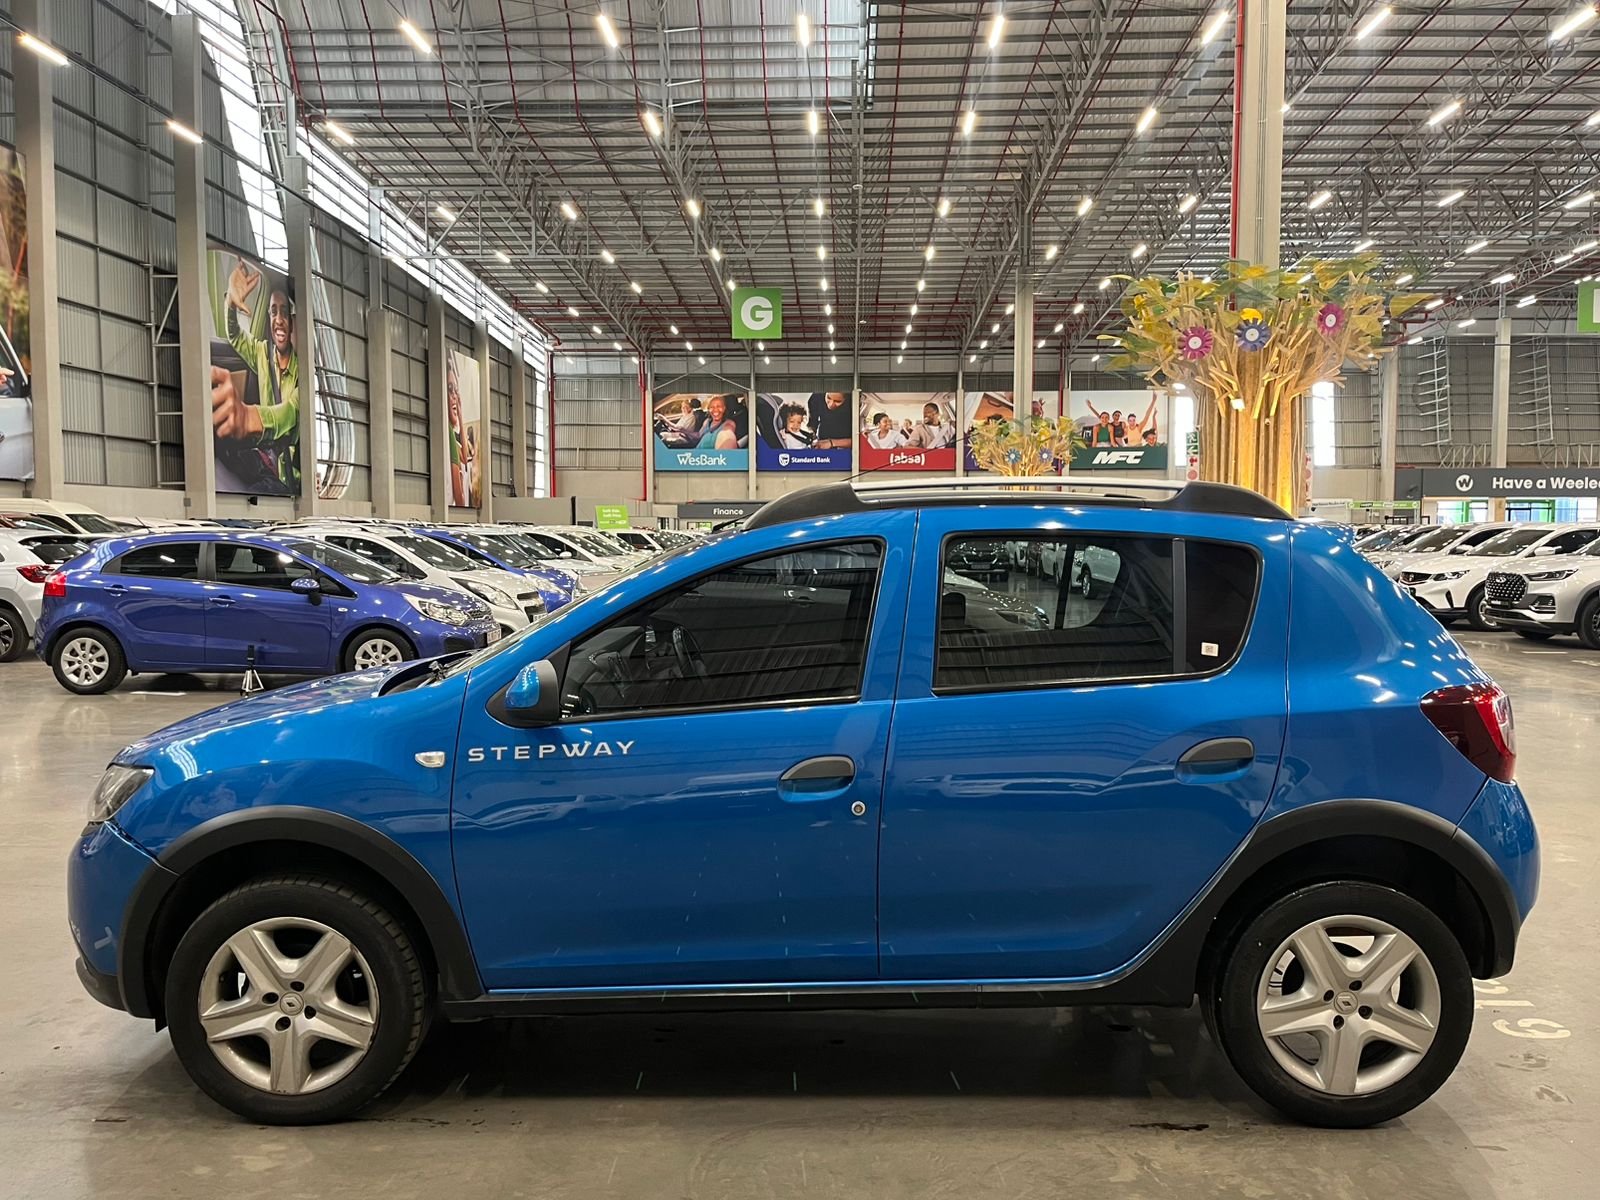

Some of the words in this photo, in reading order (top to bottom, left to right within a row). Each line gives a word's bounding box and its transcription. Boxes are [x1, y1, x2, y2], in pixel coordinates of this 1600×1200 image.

[740, 296, 773, 330] G
[676, 452, 727, 466] WesBank
[791, 456, 816, 464] Standard
[816, 456, 831, 464] Bank
[1092, 451, 1145, 464] MFC
[1492, 476, 1533, 489] Have
[1536, 479, 1546, 489] a
[1550, 476, 1600, 489] Weele
[713, 507, 744, 515] Finance
[467, 740, 636, 762] STEPWAY
